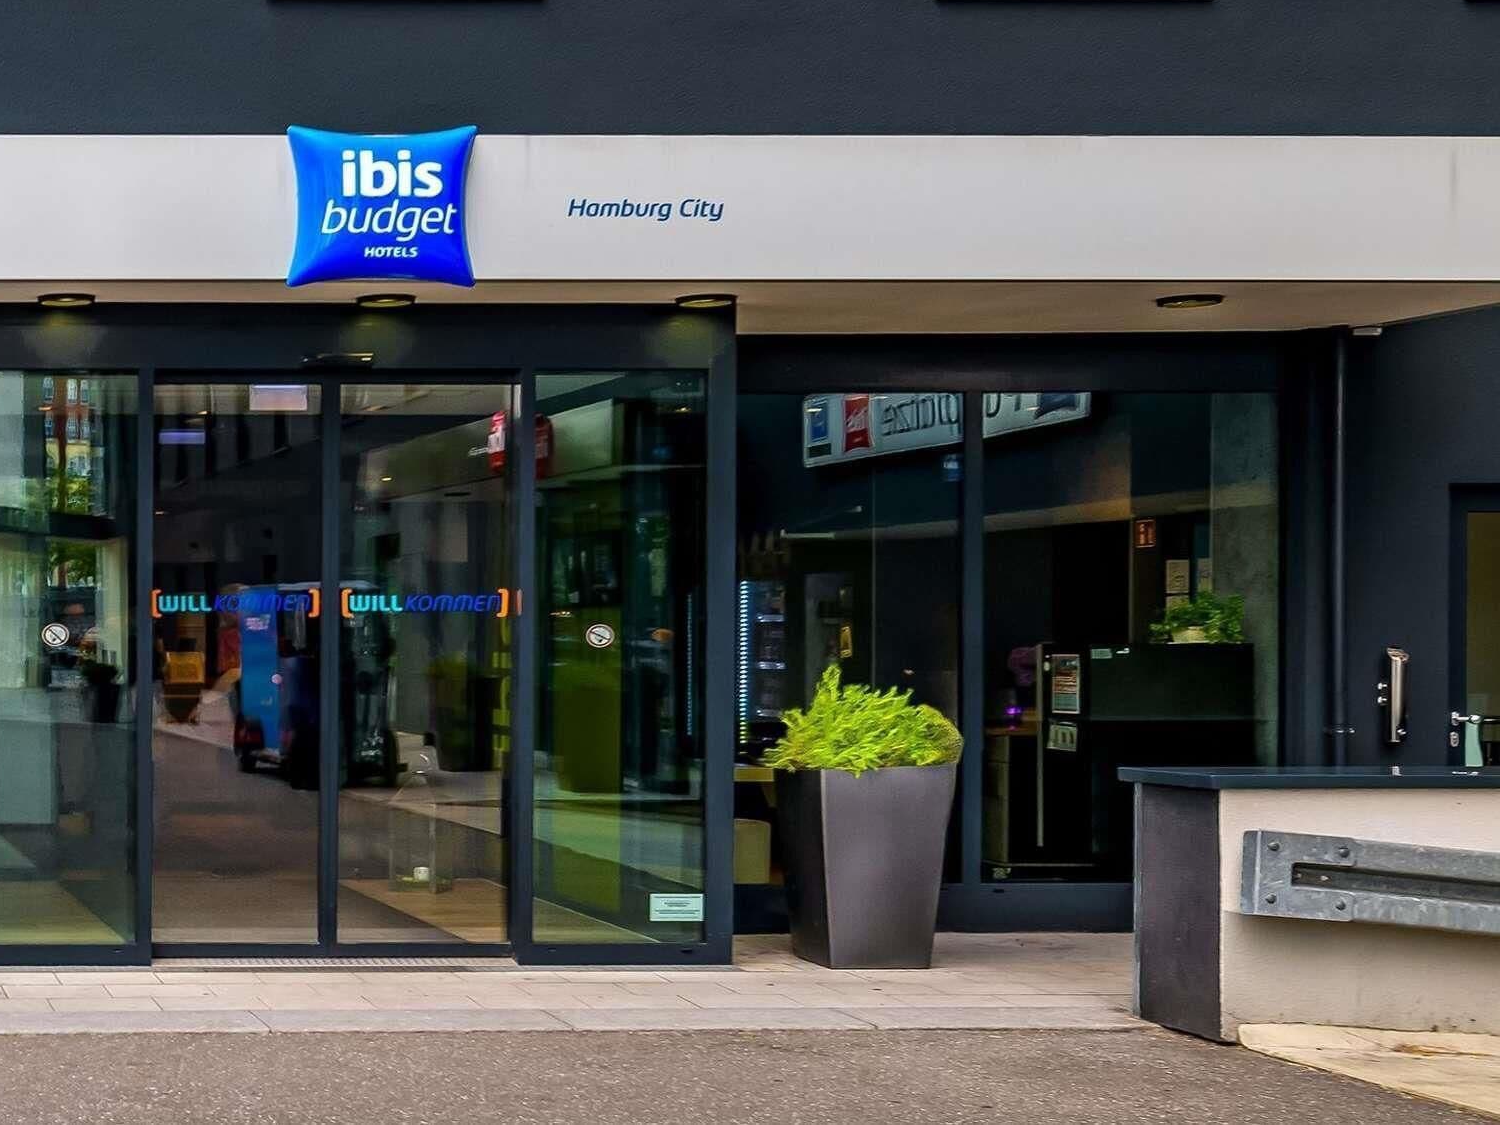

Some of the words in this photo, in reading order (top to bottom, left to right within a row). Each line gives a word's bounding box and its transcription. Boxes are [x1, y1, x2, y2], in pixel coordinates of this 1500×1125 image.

[341, 149, 443, 198] ibis
[321, 199, 457, 242] budget
[567, 198, 673, 222] Hamburg
[679, 198, 725, 222] City
[363, 246, 419, 258] HOTELS
